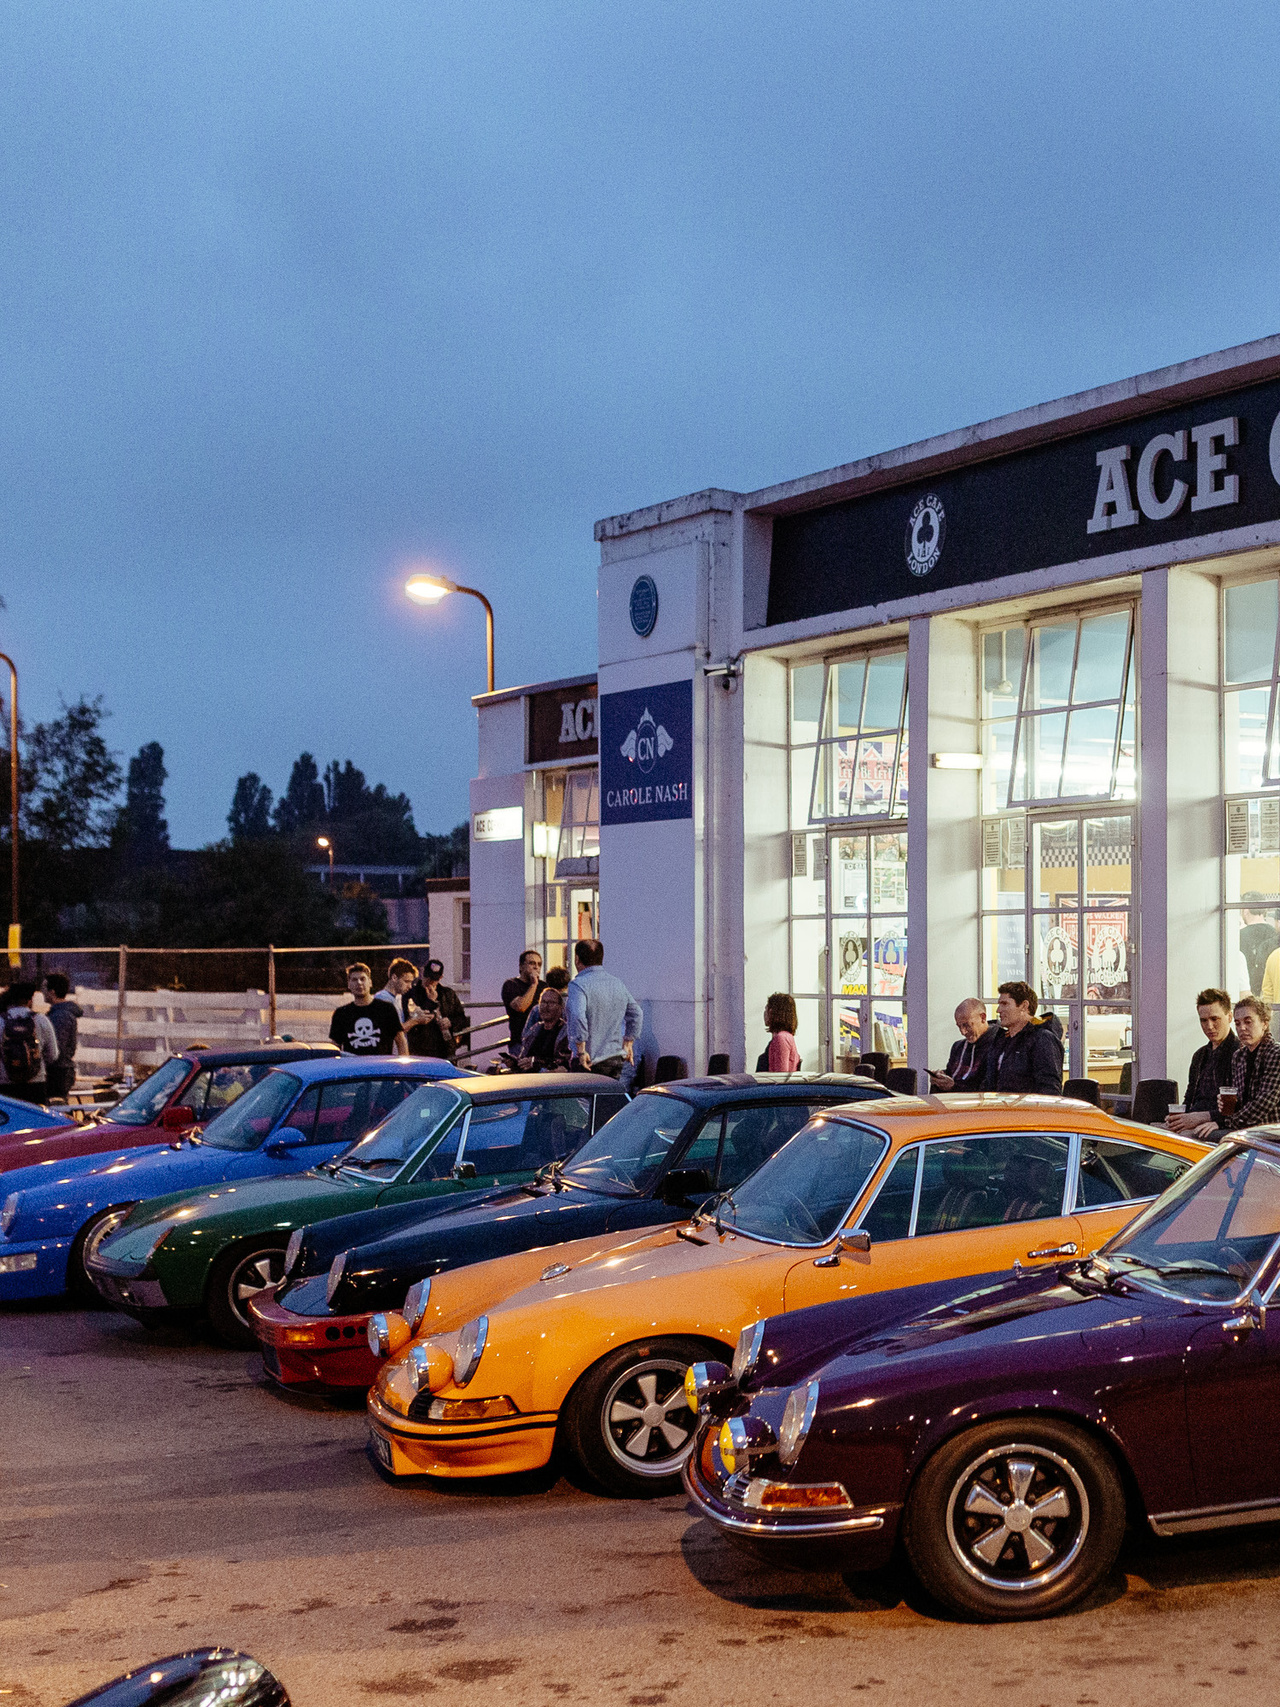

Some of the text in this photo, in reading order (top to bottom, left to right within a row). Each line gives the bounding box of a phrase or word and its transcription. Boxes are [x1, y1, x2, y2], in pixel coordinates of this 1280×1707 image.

[1087, 417, 1240, 534] ACE
[909, 495, 946, 527] ACE CAFE
[907, 547, 941, 574] LONDON
[637, 736, 655, 761] CN
[606, 782, 689, 808] CAROLE NASH
[1094, 912, 1126, 920] WALKER
[841, 984, 868, 995] MAN
